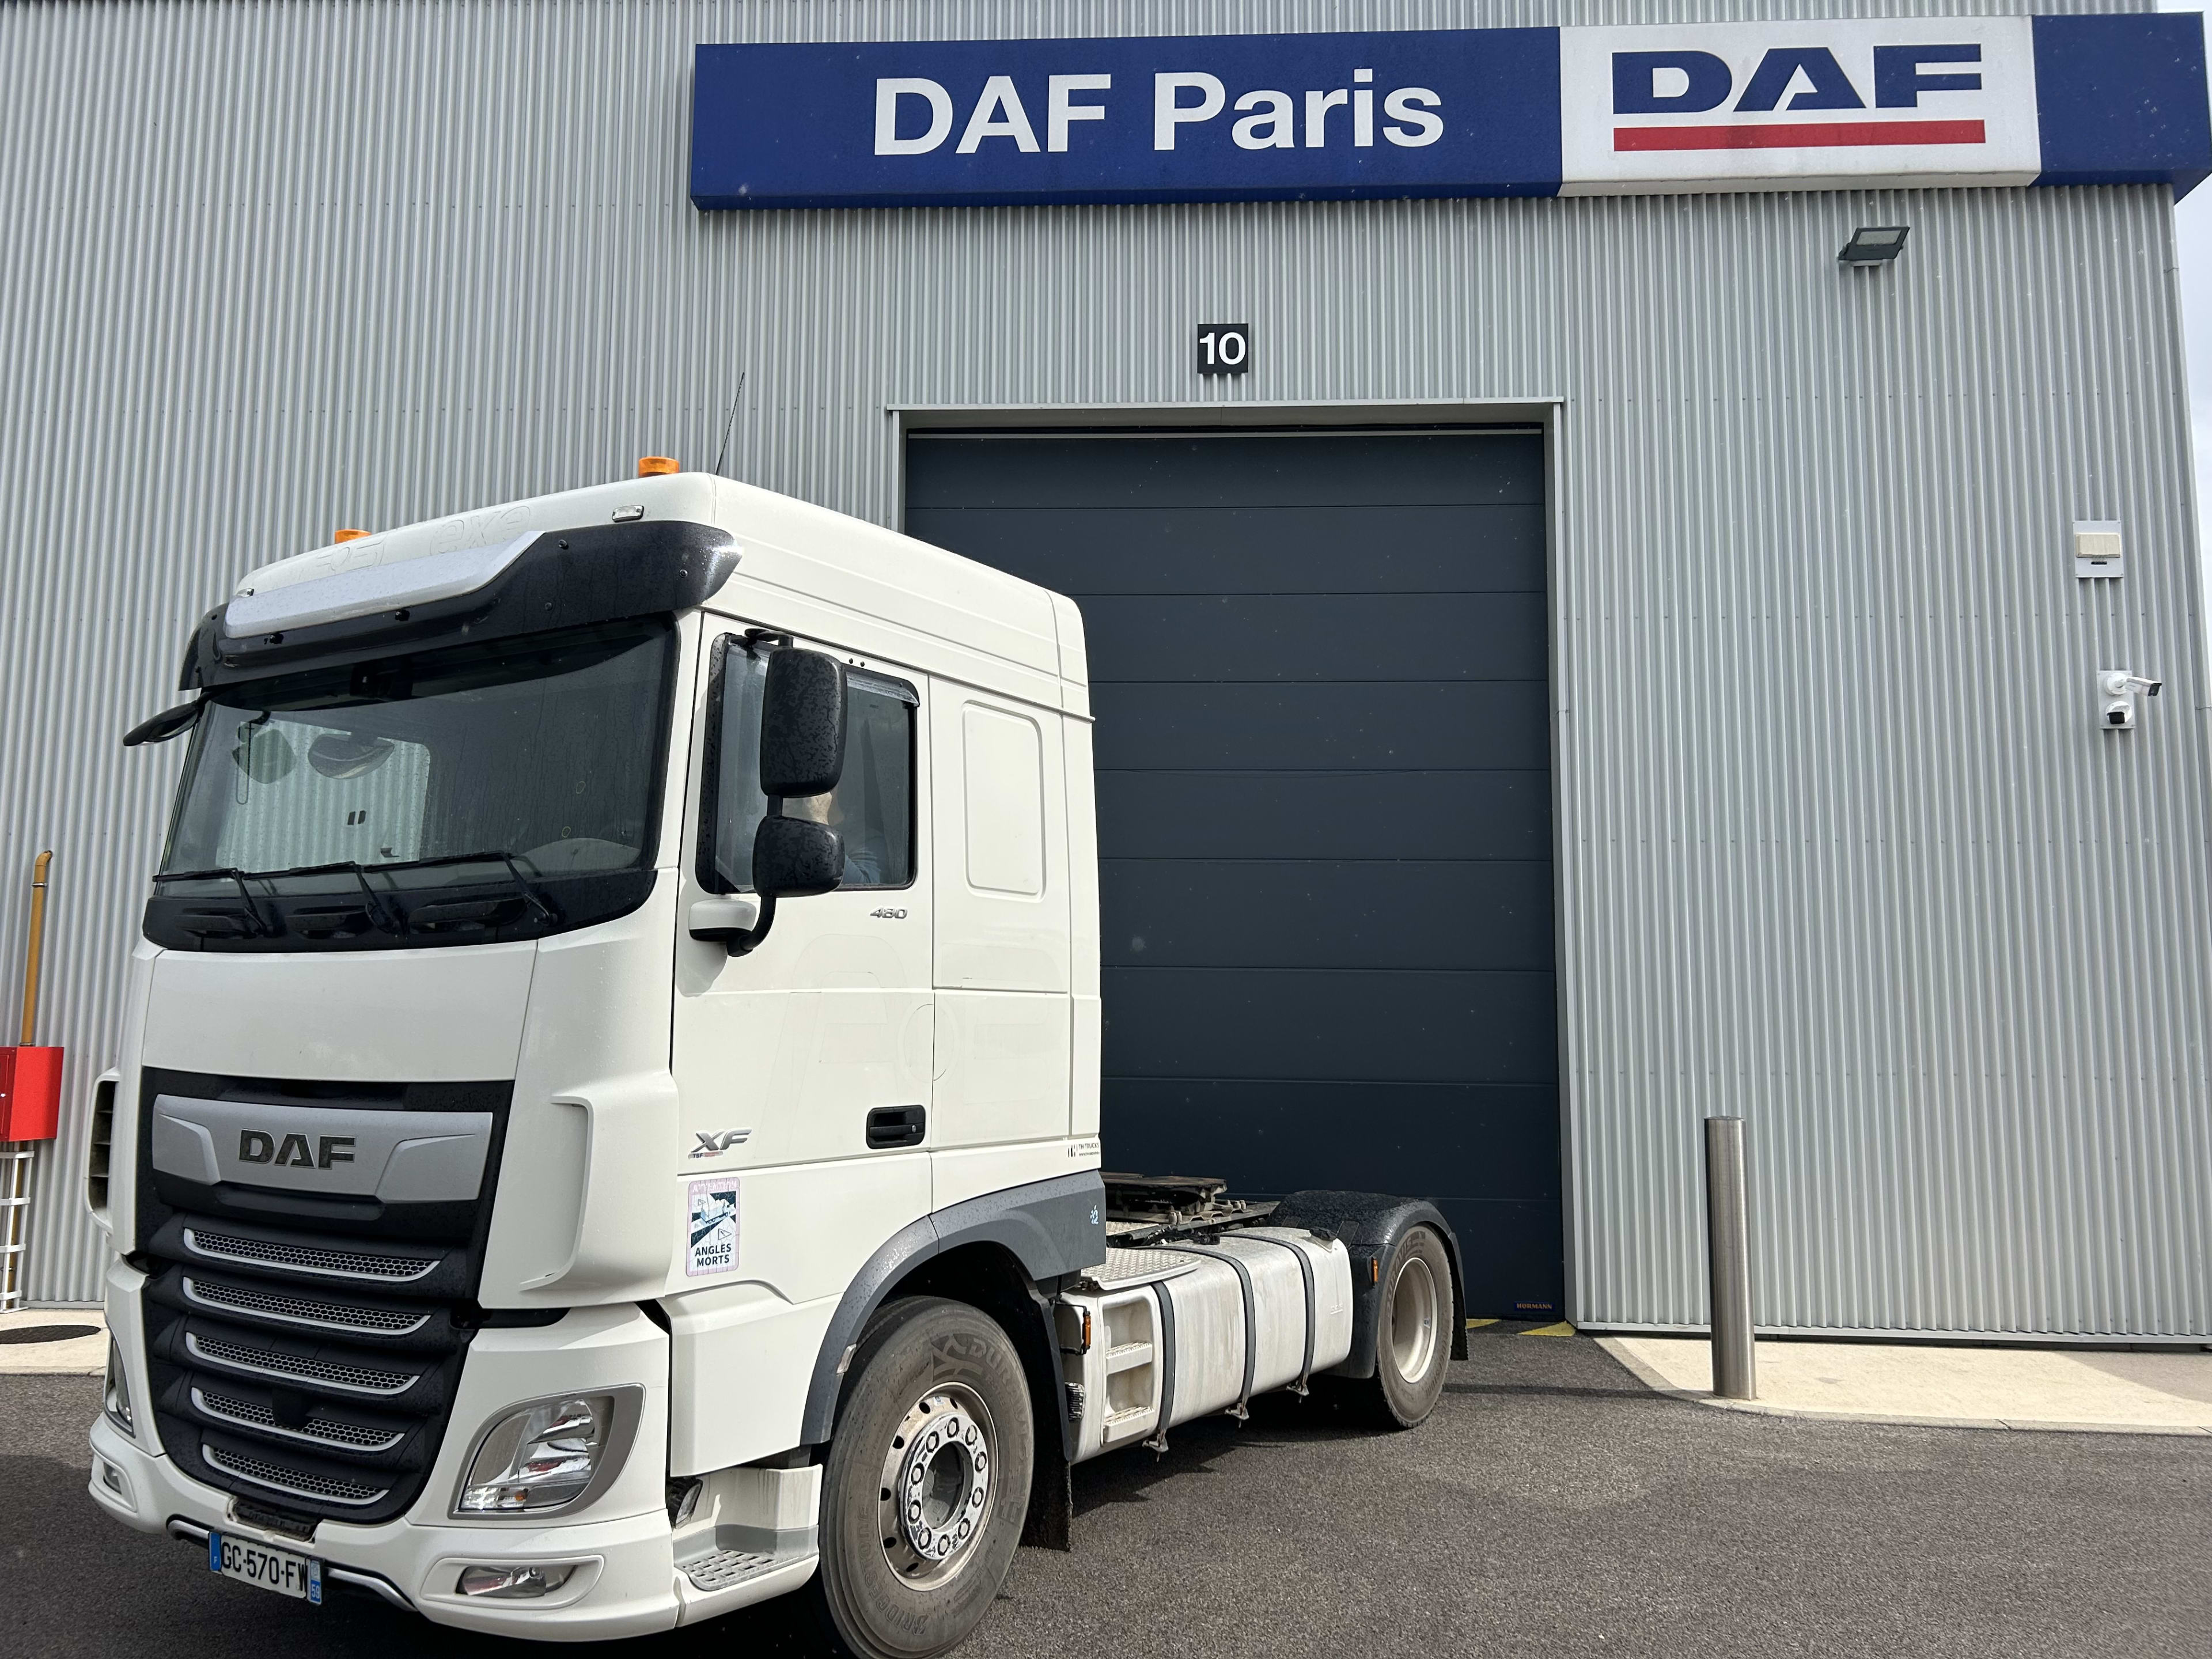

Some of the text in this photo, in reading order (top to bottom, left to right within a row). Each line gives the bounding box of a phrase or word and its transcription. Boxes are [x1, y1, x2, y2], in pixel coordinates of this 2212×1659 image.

[1612, 43, 1982, 115] DAF
[874, 68, 1444, 156] DAF Paris
[1199, 332, 1247, 365] 10
[870, 908, 908, 919] 480
[238, 1127, 357, 1170] DAF
[690, 1129, 752, 1153] XF
[695, 1243, 732, 1257] ANGLES
[697, 1254, 730, 1267] MORTS
[311, 1584, 320, 1598] 59
